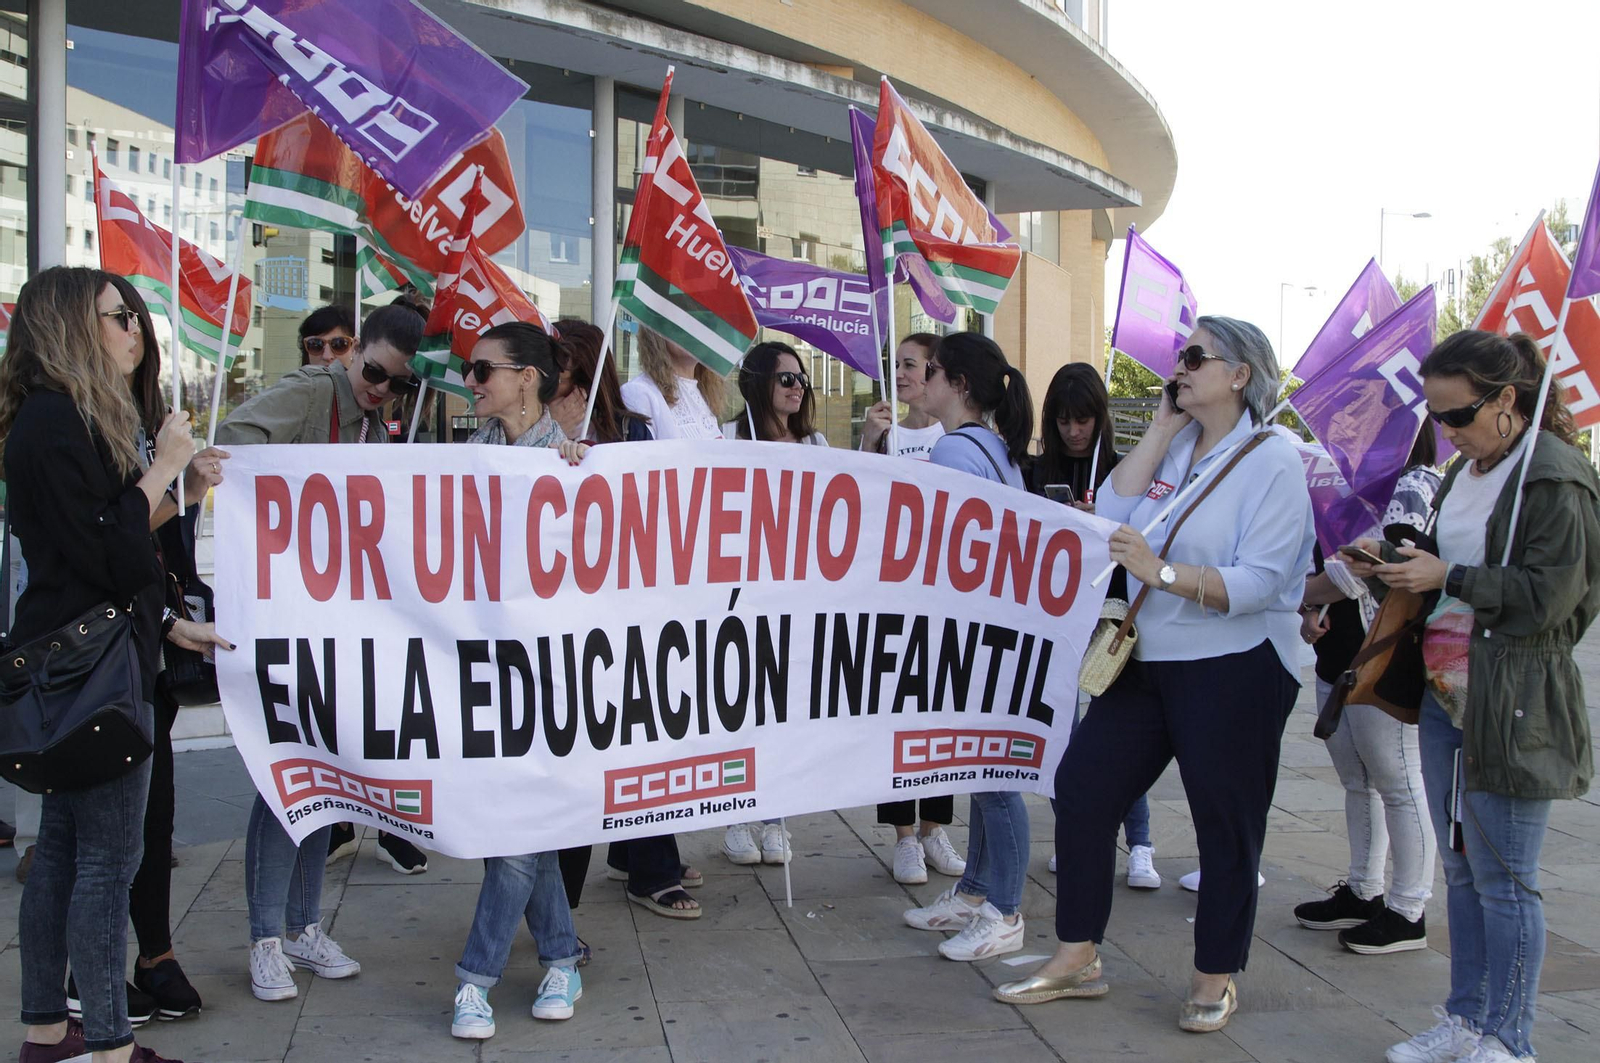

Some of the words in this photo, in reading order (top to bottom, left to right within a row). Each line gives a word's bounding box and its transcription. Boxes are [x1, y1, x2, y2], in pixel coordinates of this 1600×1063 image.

[385, 183, 455, 256] uelva
[790, 314, 869, 335] ndalucía
[898, 446, 925, 456] TTER
[255, 473, 392, 602] POR
[412, 474, 502, 603] UN
[526, 467, 861, 599] CONVENIO
[879, 481, 1082, 617] DIGNO
[255, 638, 338, 756] EN
[361, 638, 440, 760] LA
[456, 588, 791, 759] EDUCACIÓN
[809, 613, 1054, 728] INFANTIL
[892, 770, 976, 789] Enseñanza
[982, 768, 1039, 781] Huelva
[286, 797, 373, 826] Enseñanza
[377, 812, 434, 839] Huelva
[602, 807, 694, 830] Enseñanza
[700, 798, 756, 815] Huelva
